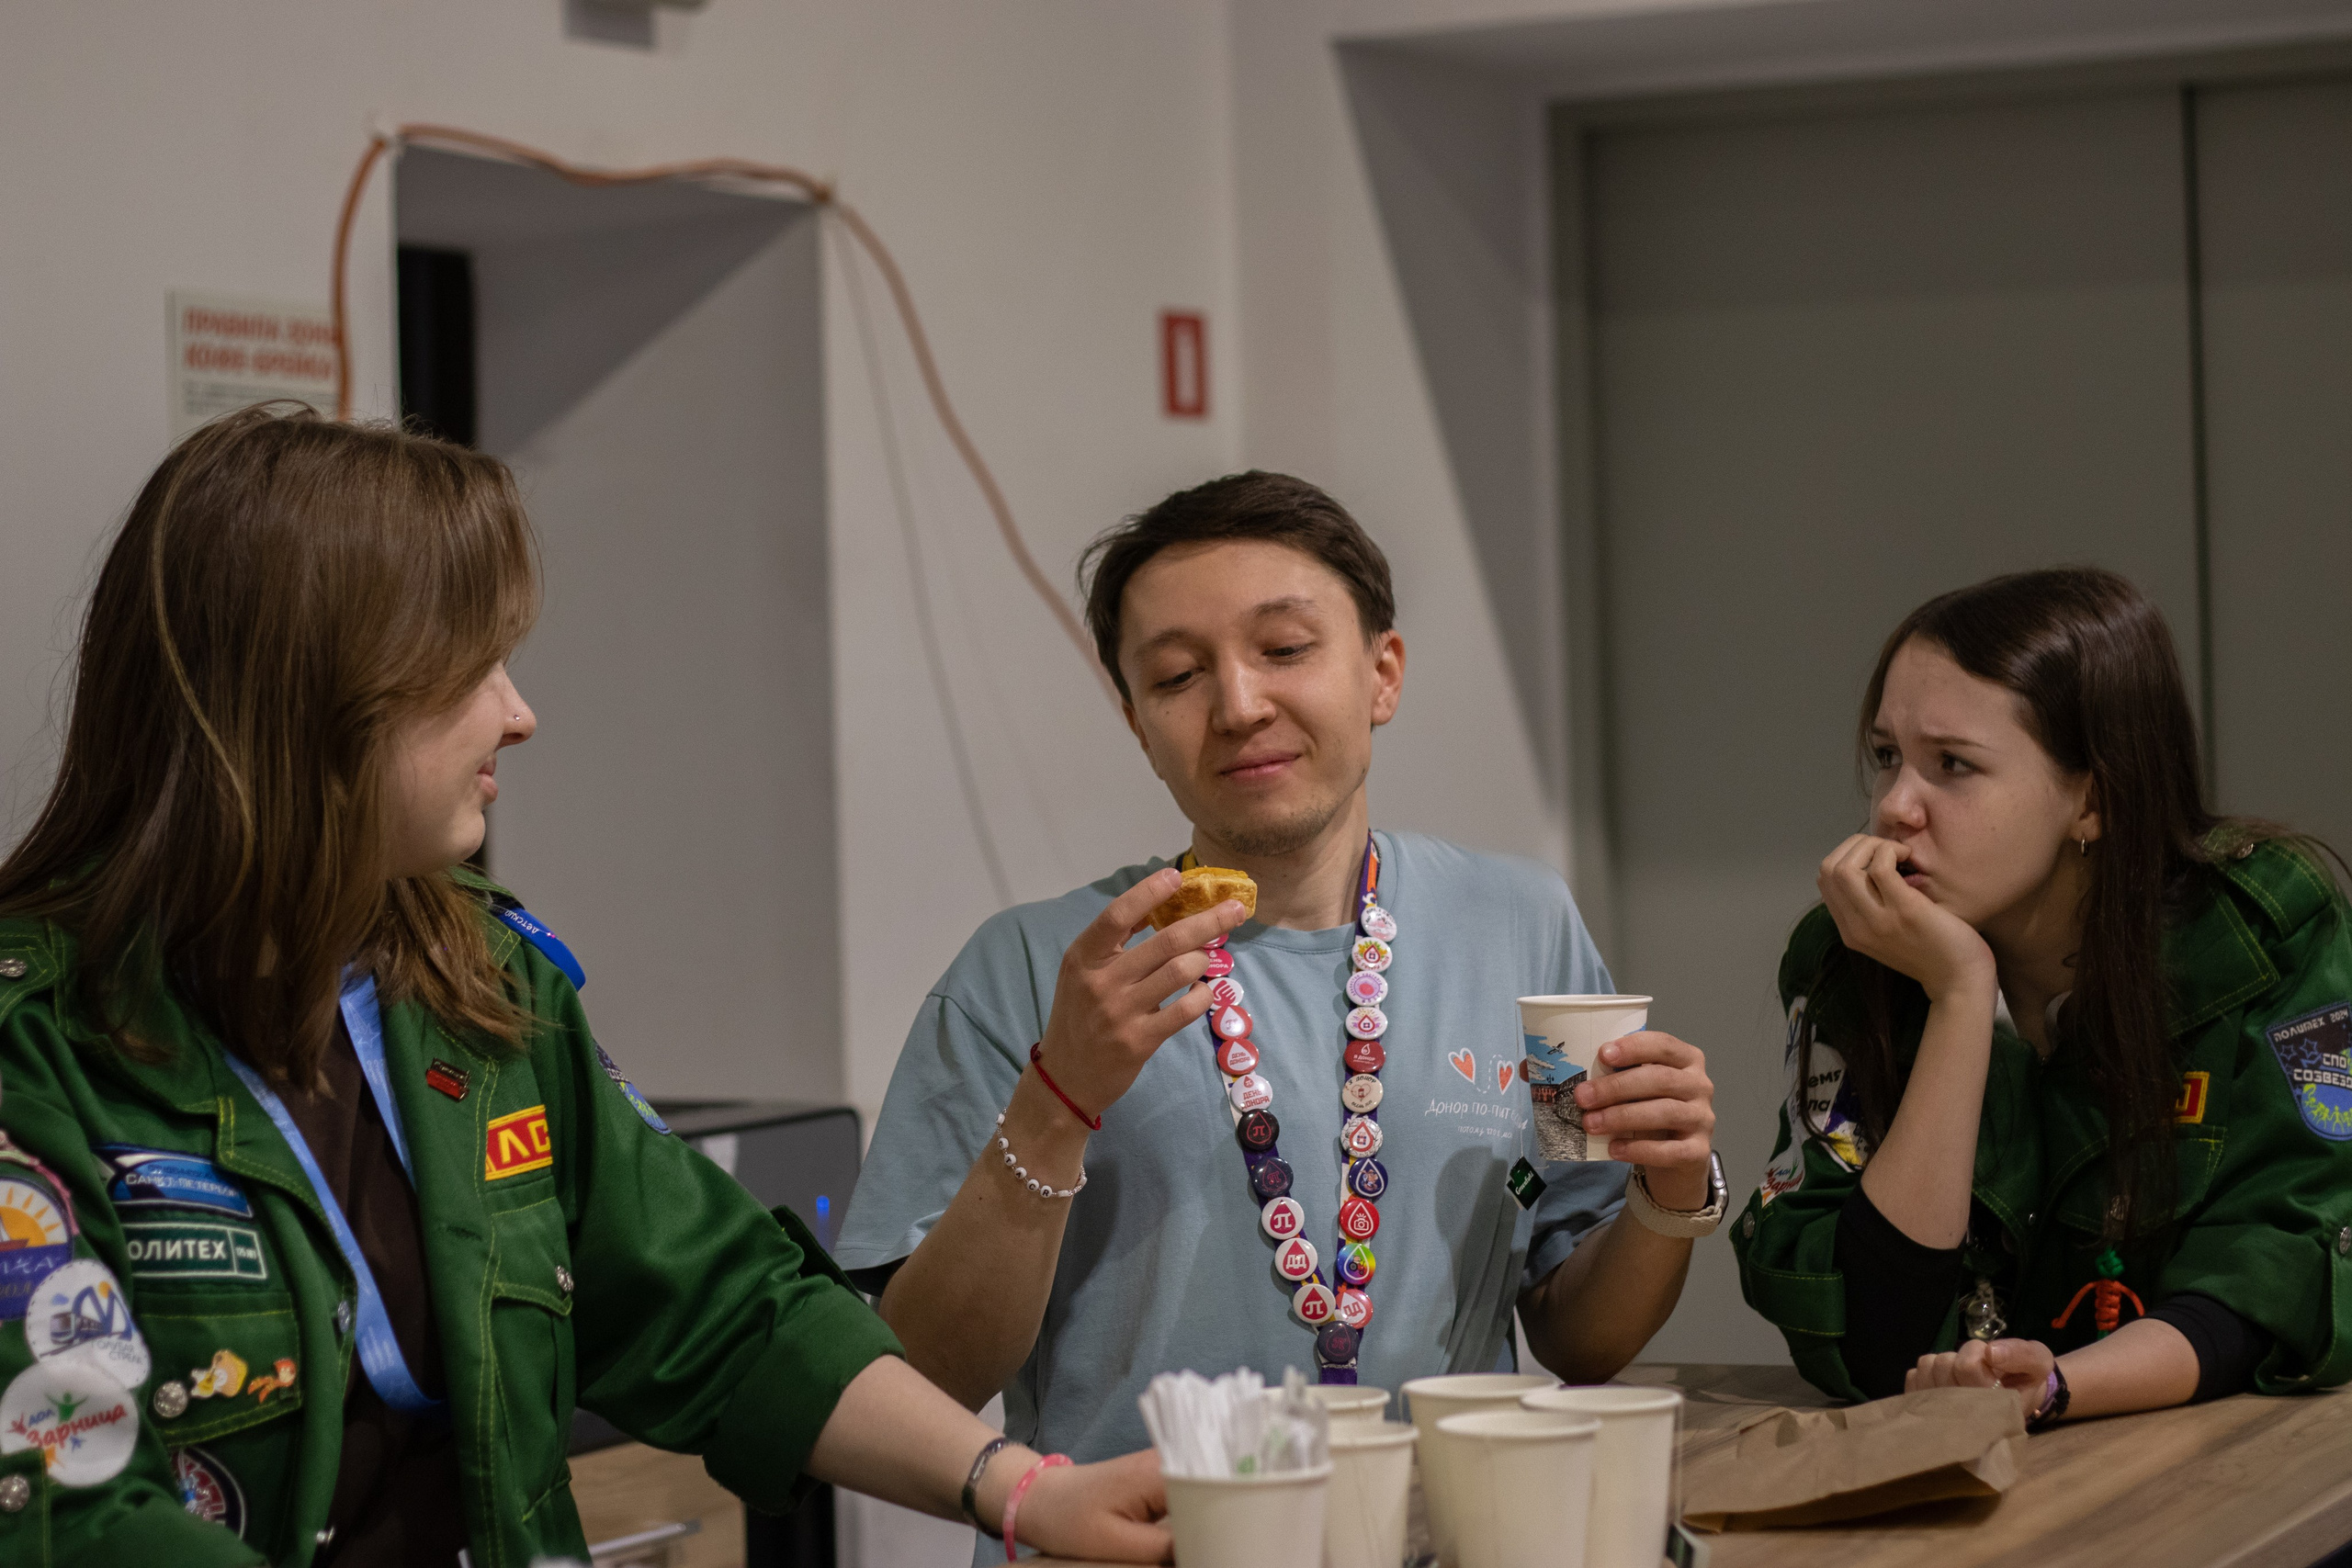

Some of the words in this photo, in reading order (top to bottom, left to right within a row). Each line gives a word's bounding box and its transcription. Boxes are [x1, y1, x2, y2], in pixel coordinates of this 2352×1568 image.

[1232, 1051, 1246, 1059] ДЕНЬ
[2323, 1053, 2348, 1069] СПО
[1243, 1089, 1263, 1100] ДЕНЬ
[1241, 1095, 1271, 1110] ДОНОРА
[128, 1238, 228, 1260] ОЛИТЕХ
